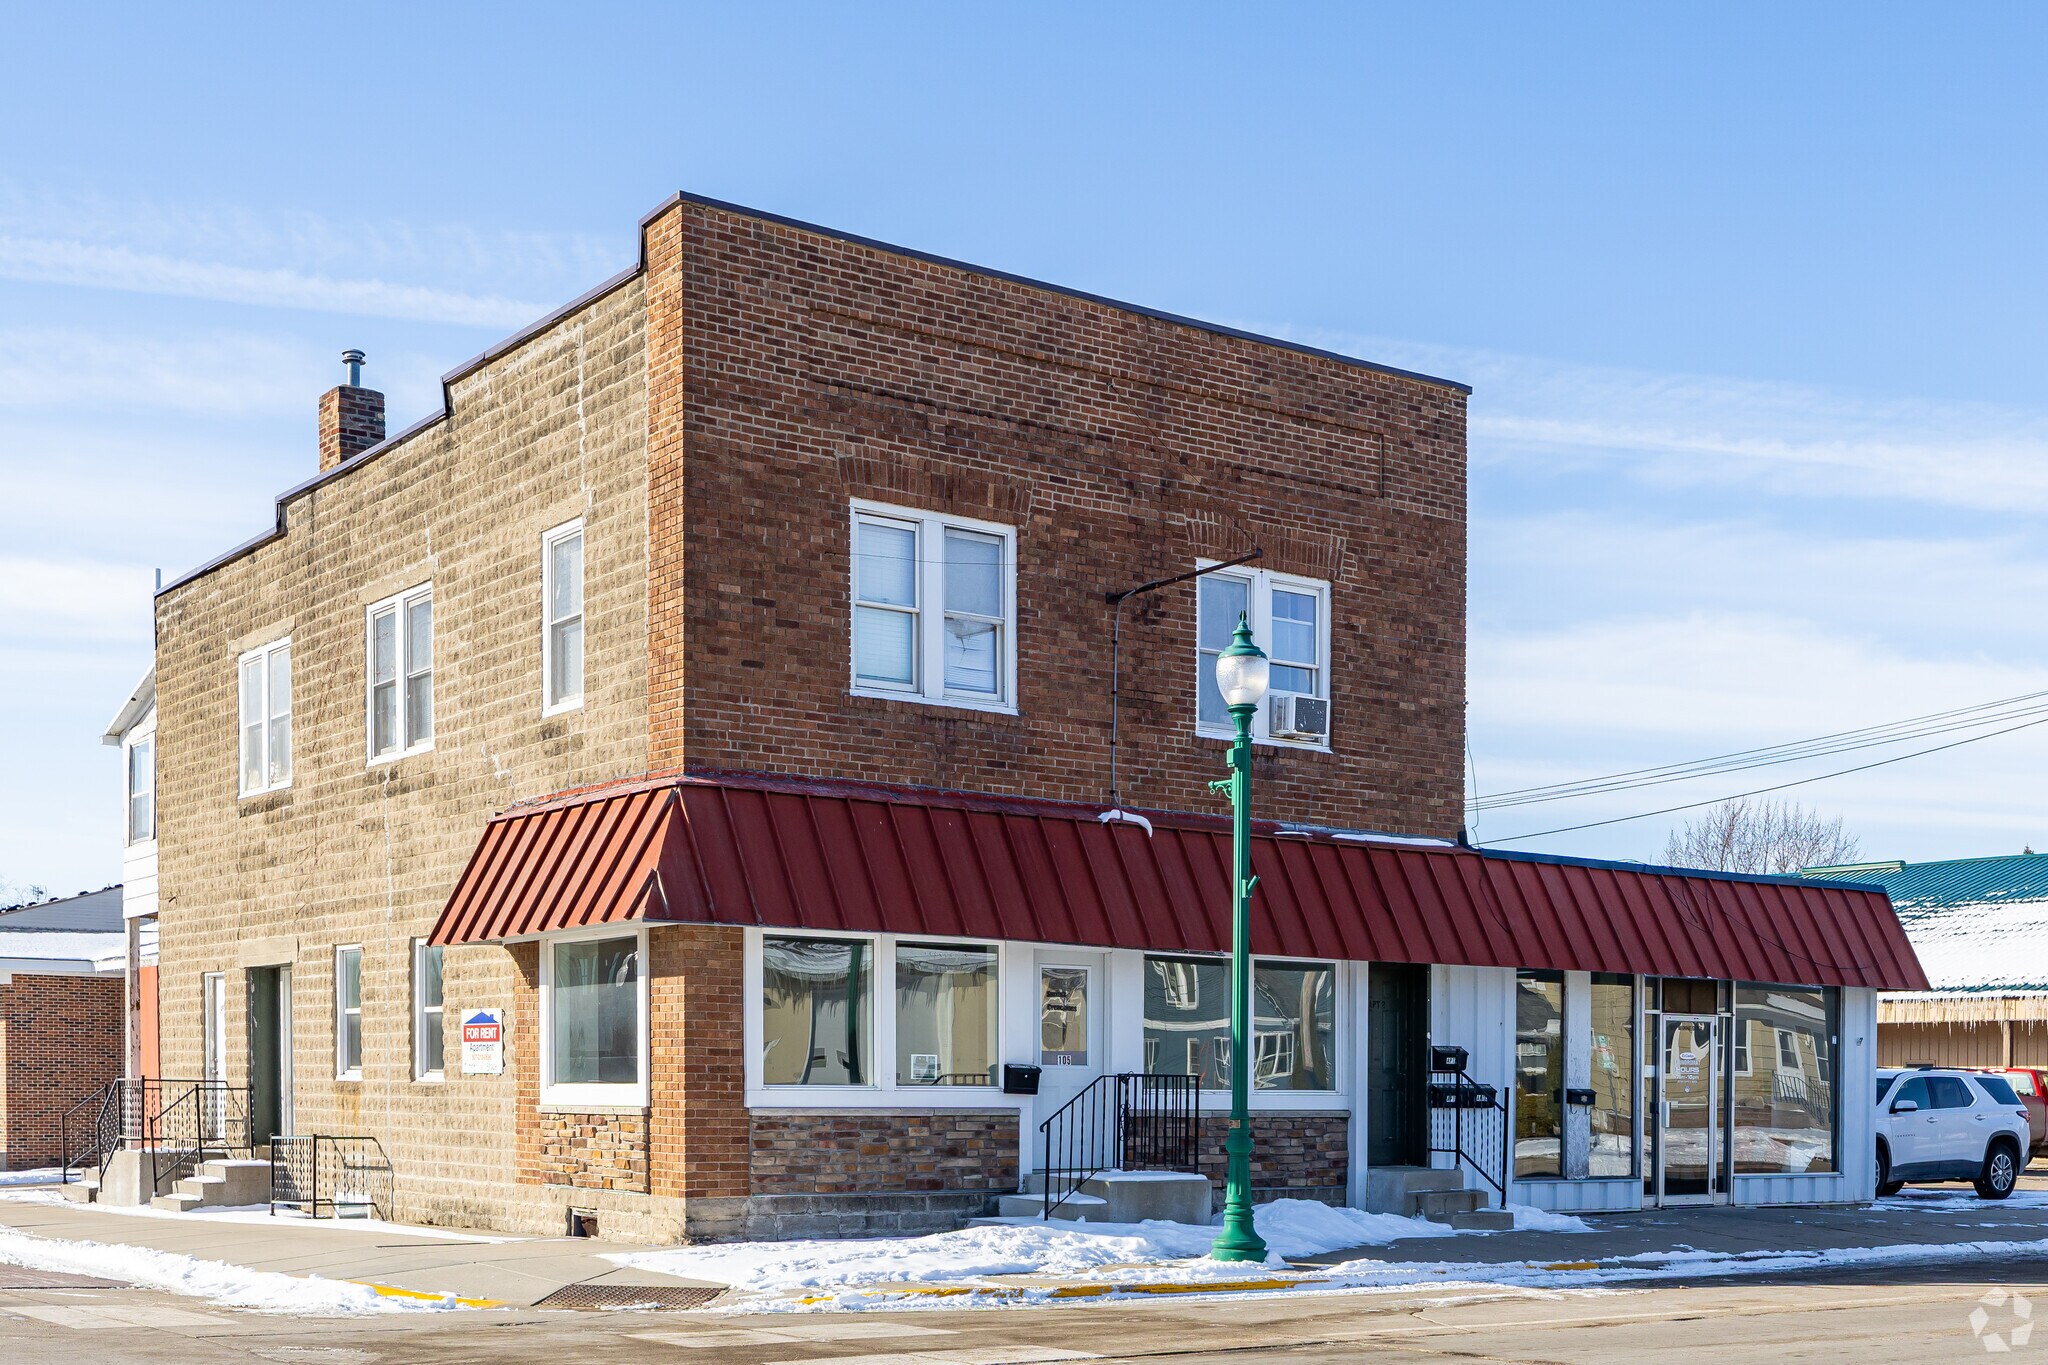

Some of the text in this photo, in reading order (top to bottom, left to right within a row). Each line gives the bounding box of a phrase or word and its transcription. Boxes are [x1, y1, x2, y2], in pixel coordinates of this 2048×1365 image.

[466, 1027, 497, 1039] FOR RENT
[1058, 1055, 1071, 1065] 105
